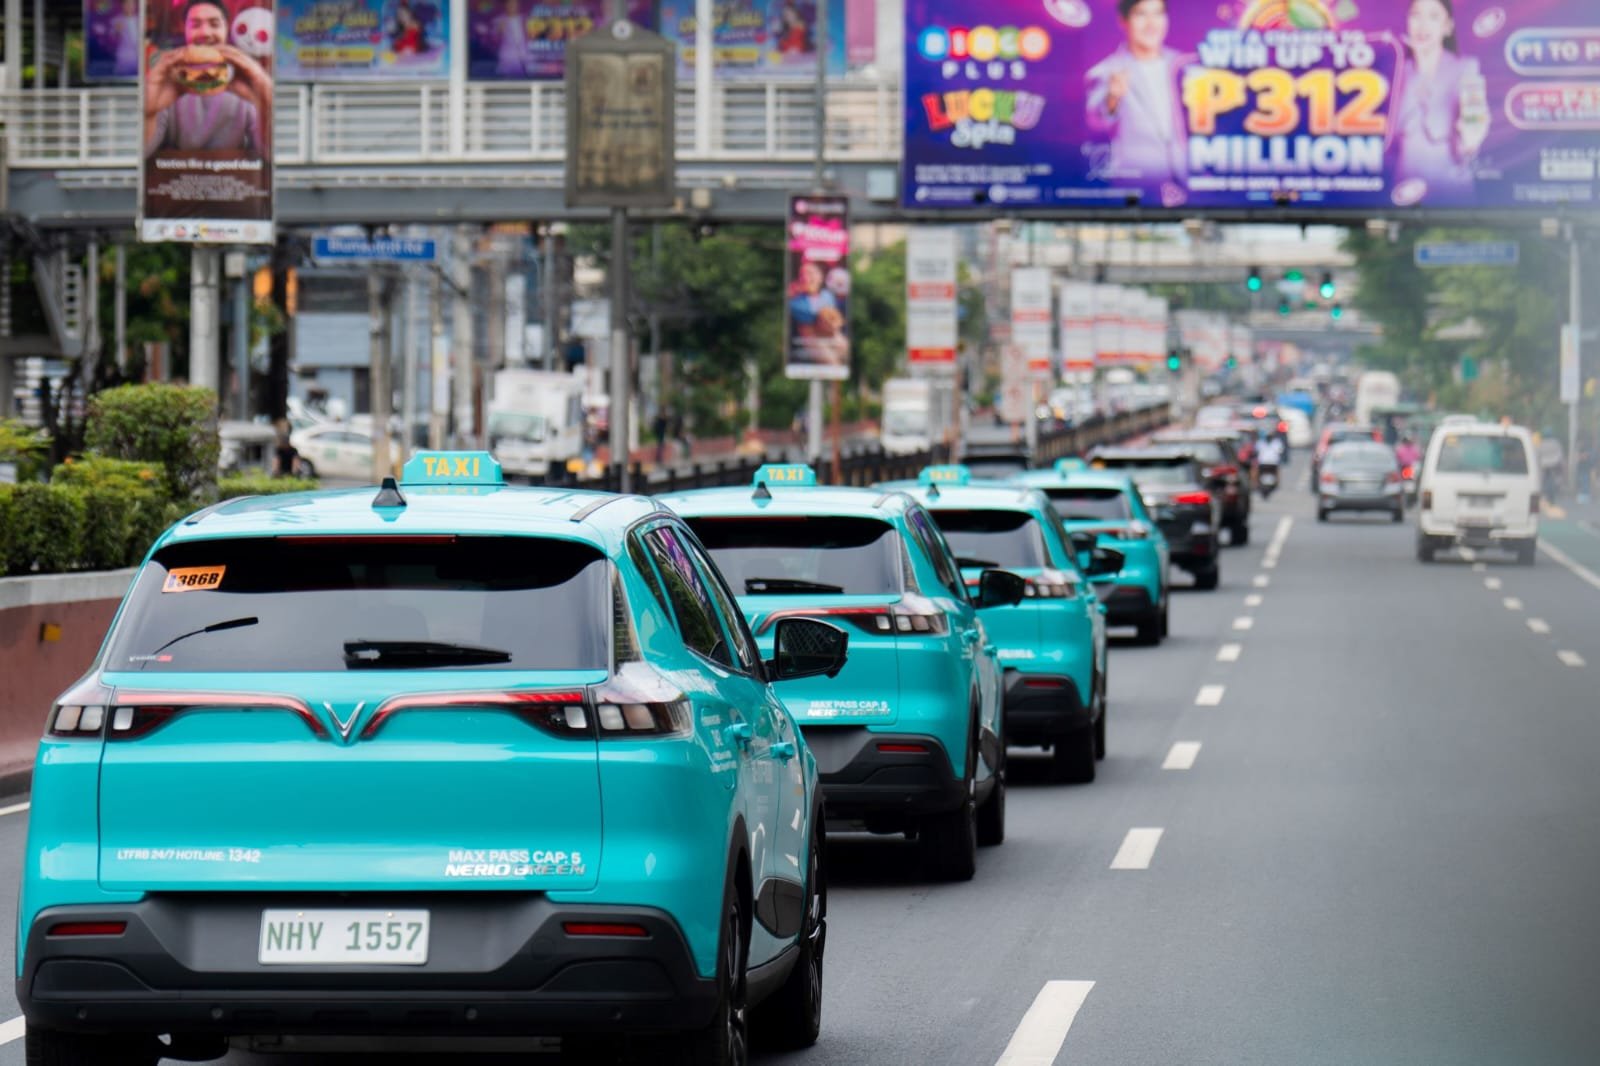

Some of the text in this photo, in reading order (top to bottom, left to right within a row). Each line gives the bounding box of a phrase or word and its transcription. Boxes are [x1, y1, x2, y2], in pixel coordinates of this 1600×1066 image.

[918, 26, 1051, 60] BINGO
[1549, 41, 1580, 61] TO
[1198, 43, 1376, 68] WIN UP TO
[941, 60, 1027, 81] PLUS
[921, 88, 1046, 131] LUCKY
[1182, 66, 1389, 135] P312
[950, 117, 1016, 149] Spin
[1188, 135, 1384, 174] MILLION
[423, 457, 480, 477] TAXI
[767, 469, 804, 480] TAXI
[117, 848, 149, 861] LTFRB
[151, 849, 175, 861] 24/7
[229, 847, 262, 863] 1342
[448, 849, 582, 866] MAX PASS CAP: 5
[445, 863, 586, 877] NERIO GREEN
[267, 921, 423, 951] NHY 1557
